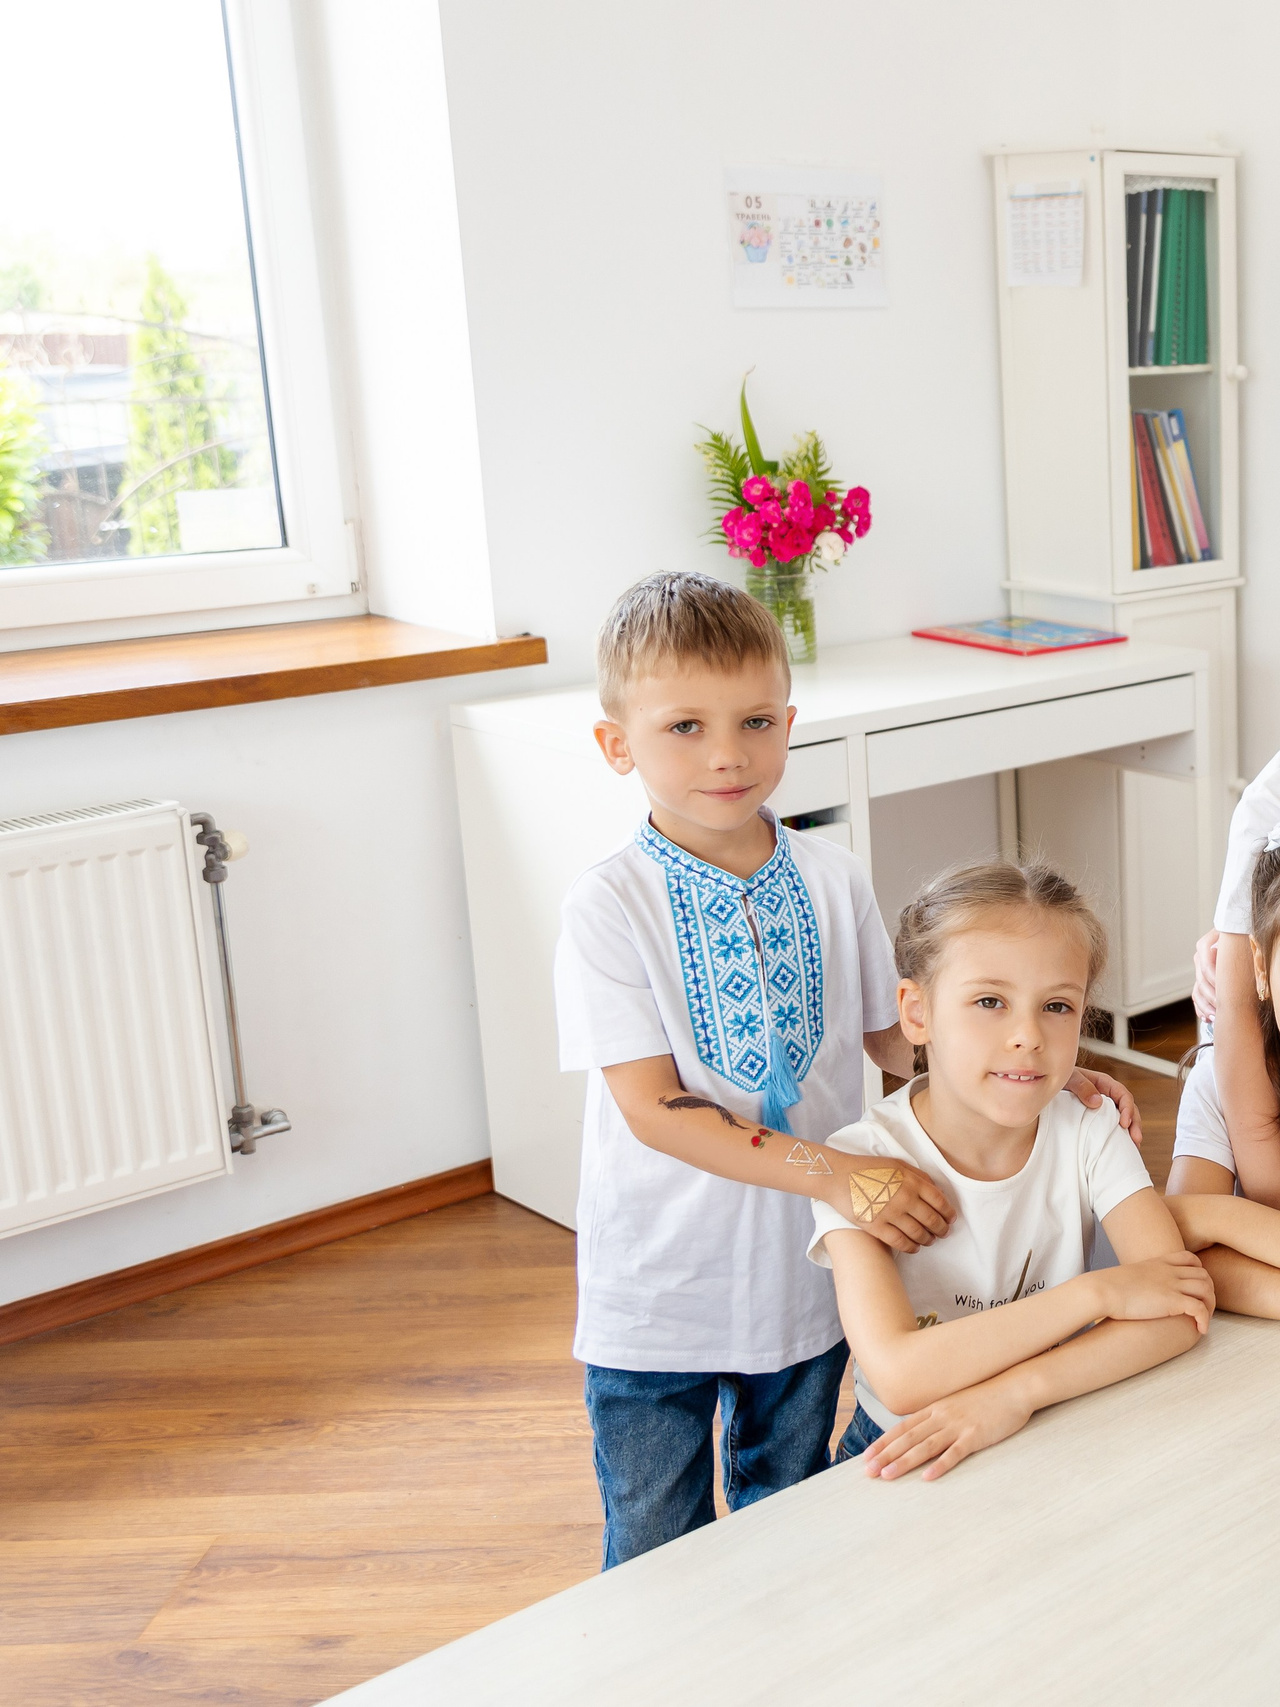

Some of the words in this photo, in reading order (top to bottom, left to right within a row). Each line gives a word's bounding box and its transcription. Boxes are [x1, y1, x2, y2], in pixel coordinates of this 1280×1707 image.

[745, 196, 762, 209] 05
[736, 212, 772, 221] ТРАВЕНЬ
[955, 1294, 984, 1311] Wish
[1024, 1280, 1045, 1298] you
